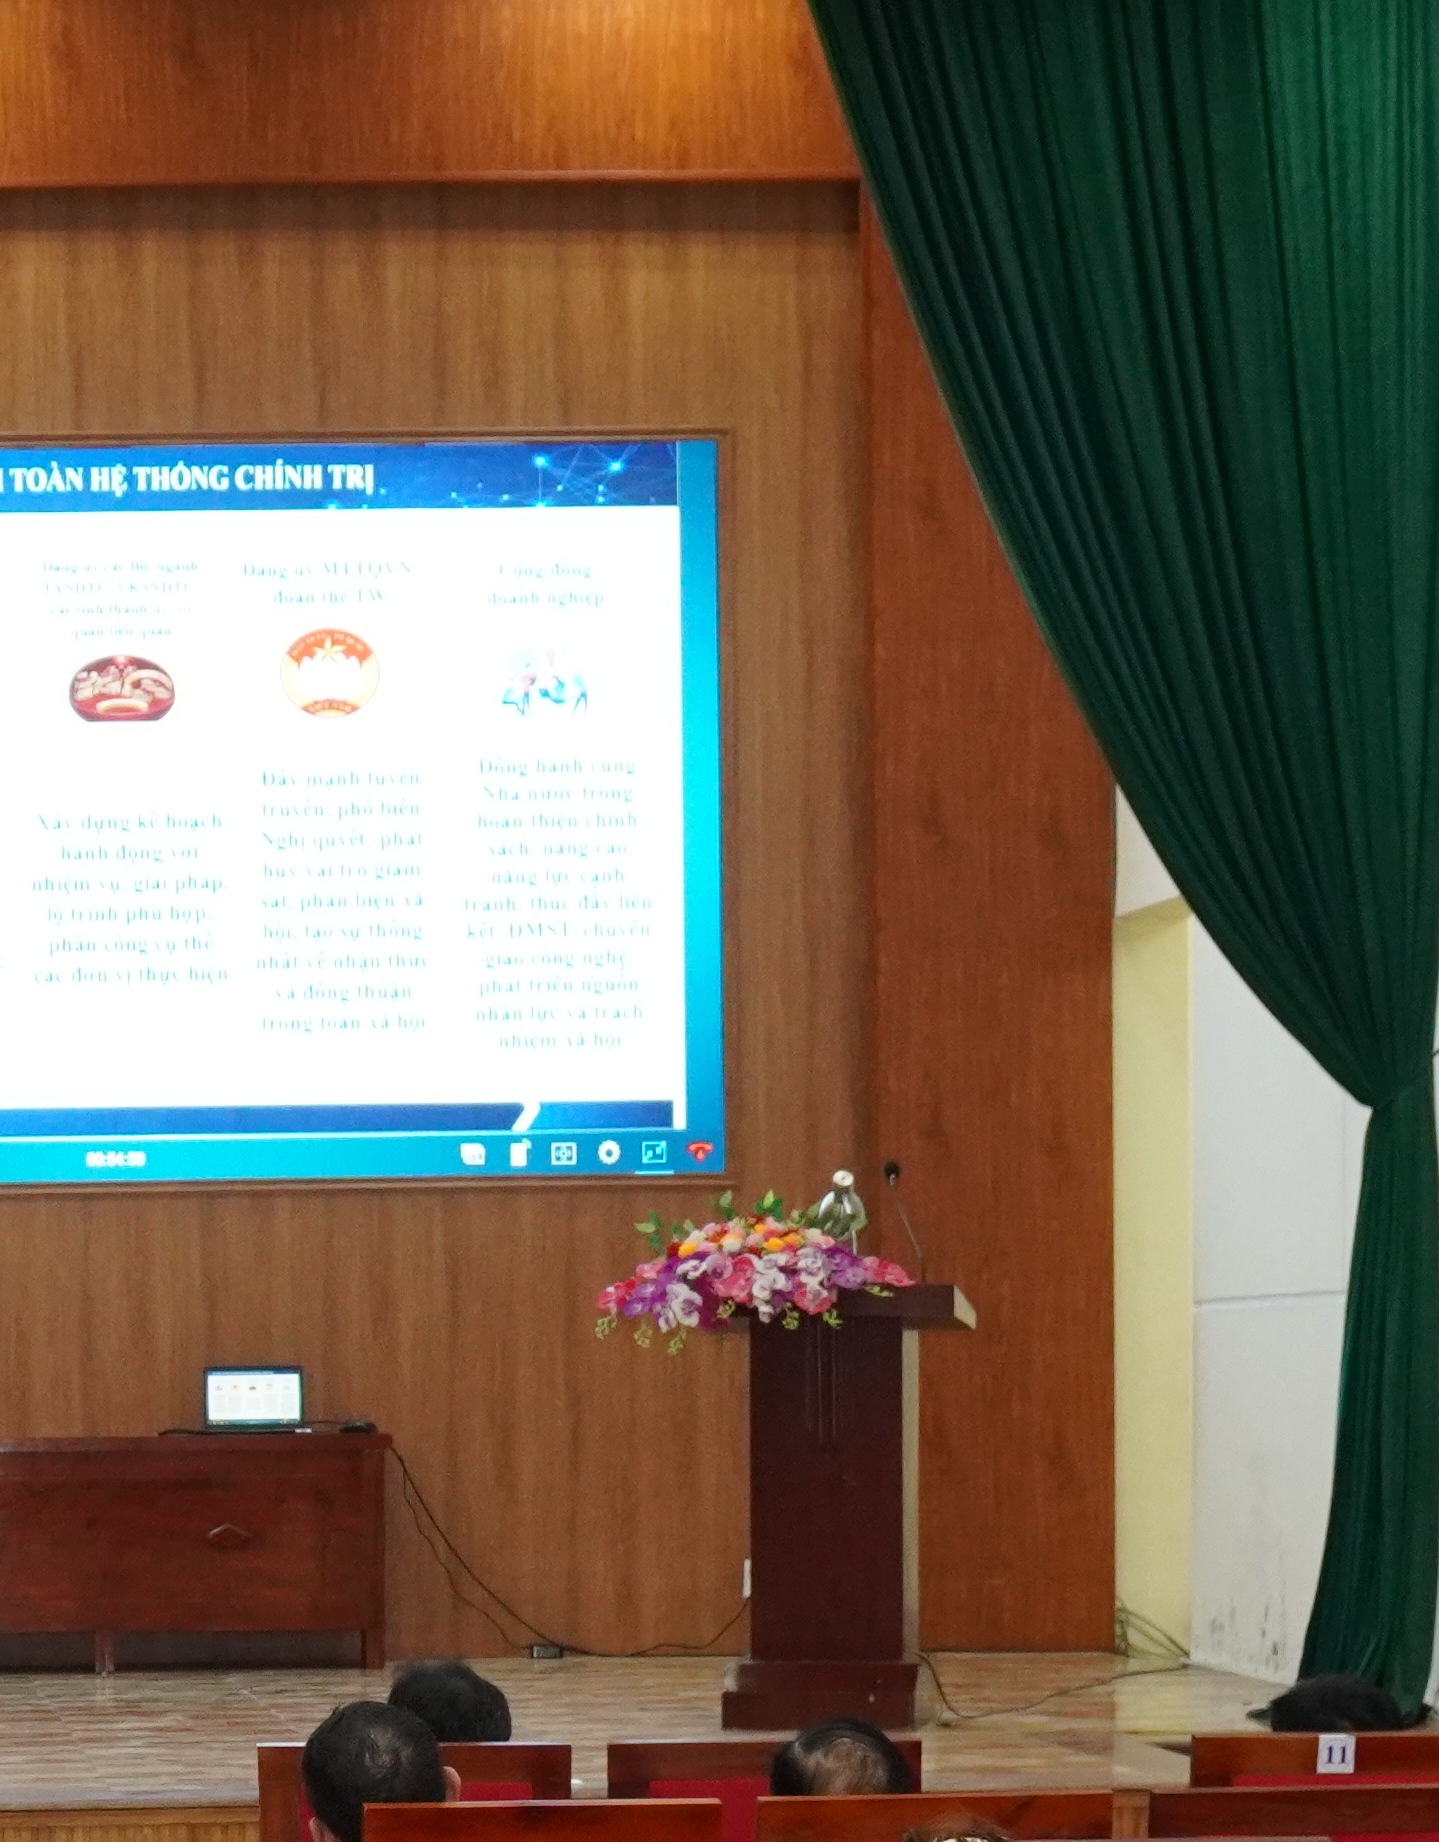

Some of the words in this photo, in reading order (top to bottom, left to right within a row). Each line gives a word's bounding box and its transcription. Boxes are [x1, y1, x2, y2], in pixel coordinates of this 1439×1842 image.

[9, 461, 83, 492] TOÀN
[90, 463, 126, 497] HỆ
[235, 459, 322, 491] CHÍNH
[328, 463, 374, 494] TRỊ
[1326, 1745, 1346, 1764] 11
